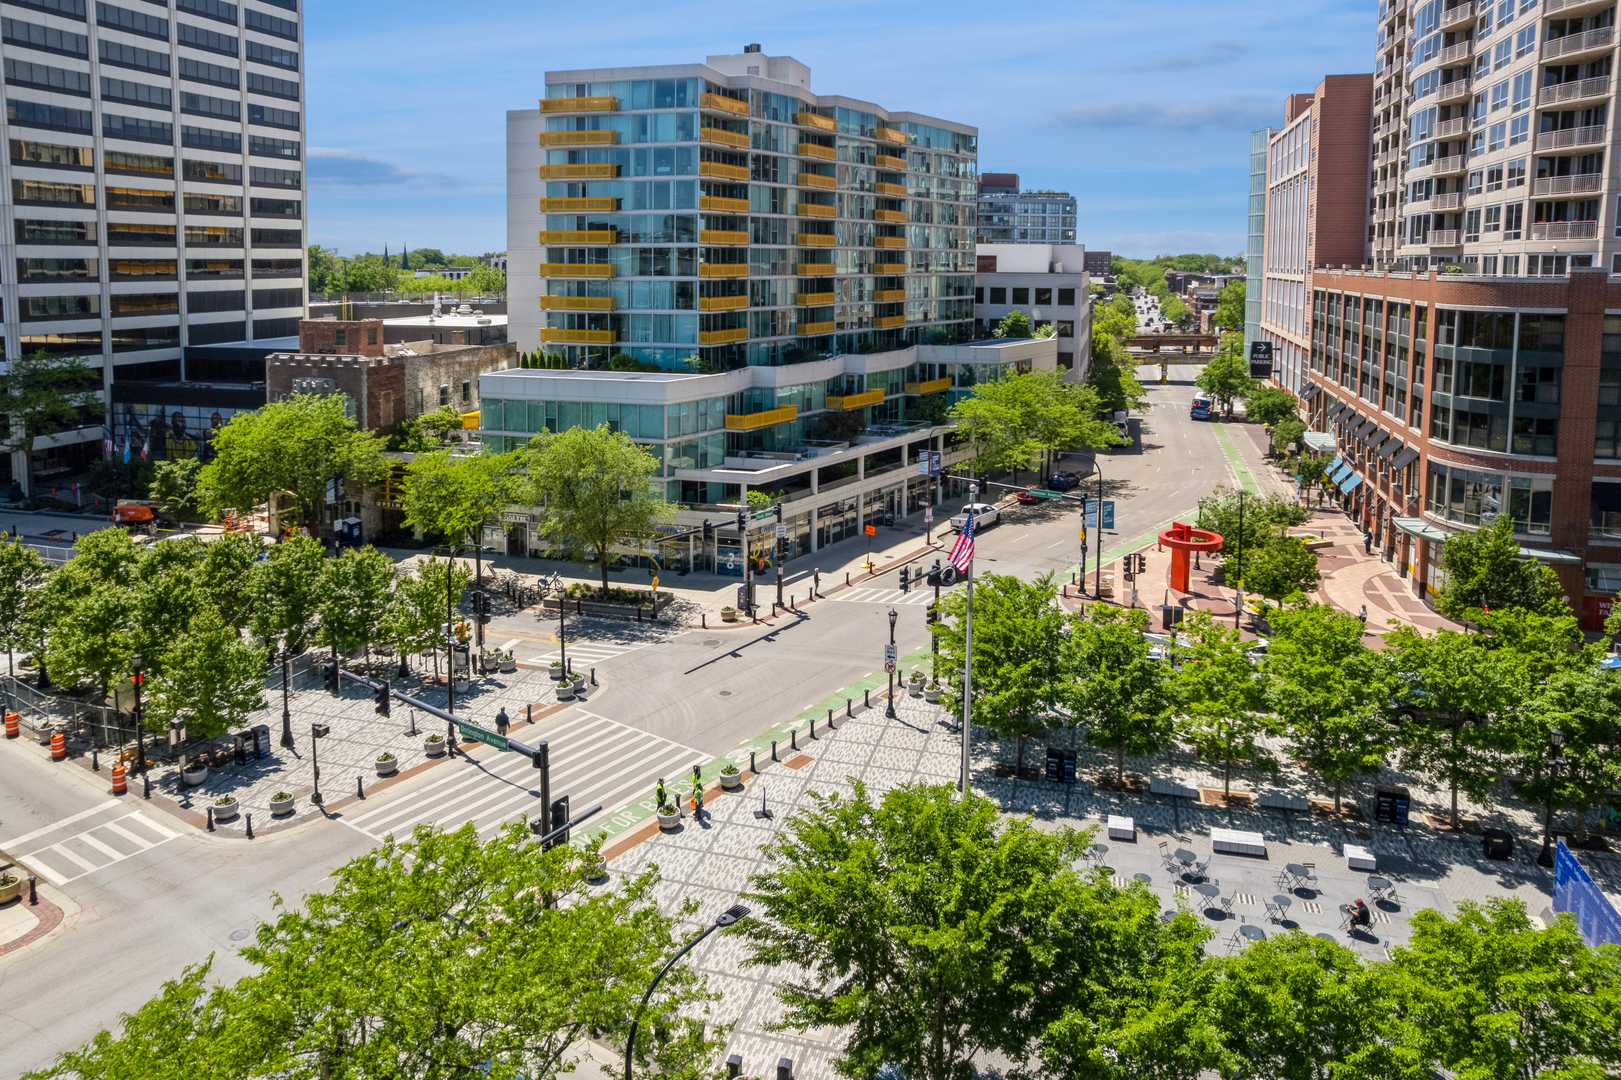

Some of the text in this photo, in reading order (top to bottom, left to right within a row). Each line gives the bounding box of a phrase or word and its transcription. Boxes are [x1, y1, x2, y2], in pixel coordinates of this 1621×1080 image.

[376, 501, 401, 509] OPTIM
[460, 725, 507, 748] Orrington Avenue
[598, 810, 642, 835] FOR
